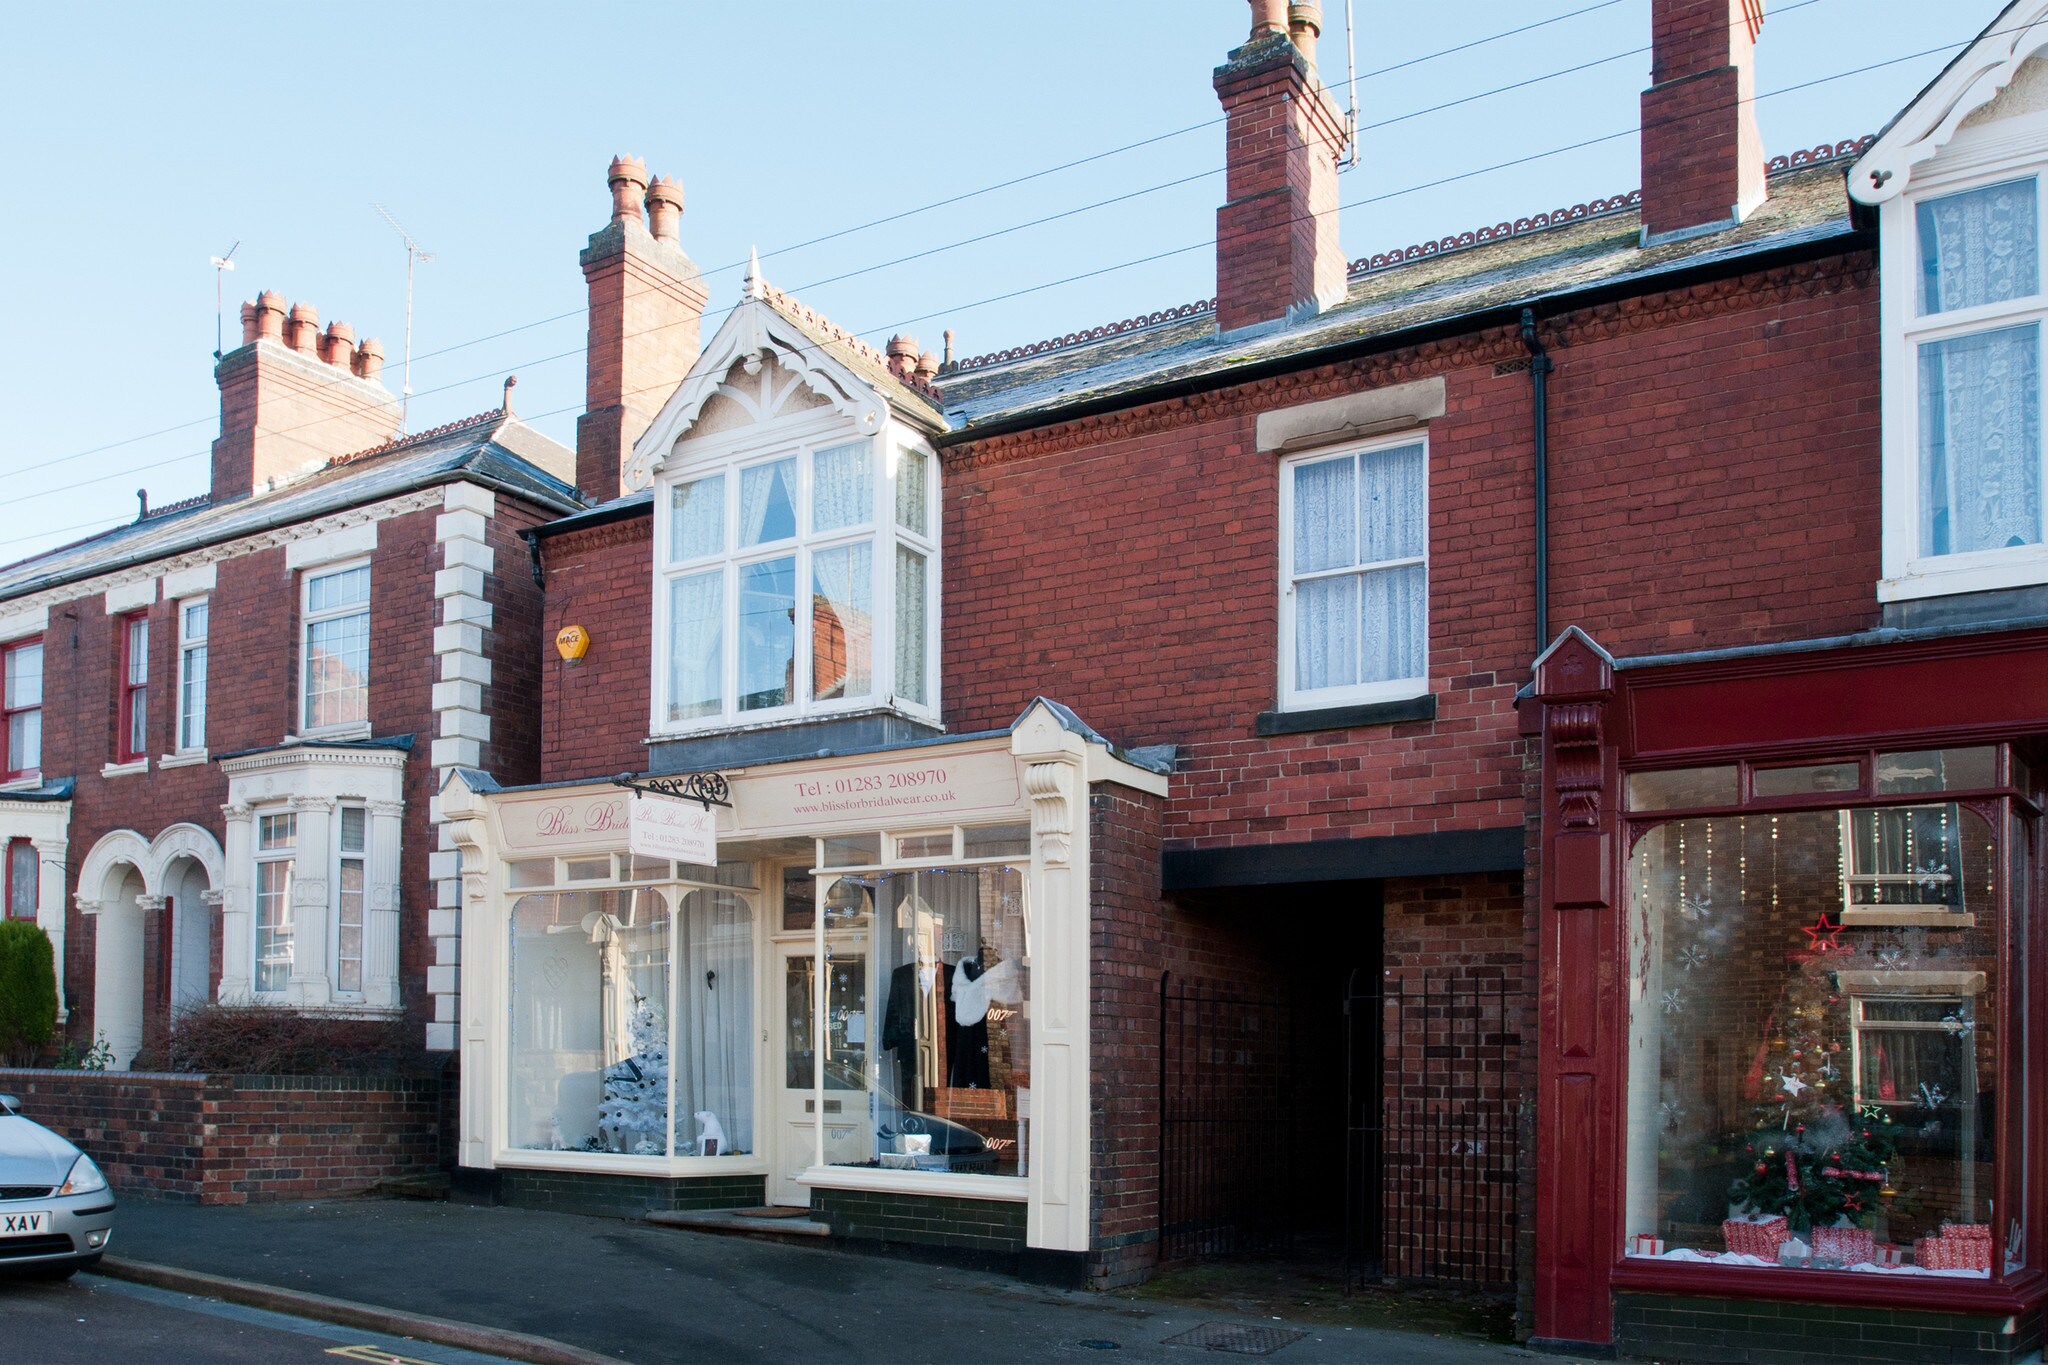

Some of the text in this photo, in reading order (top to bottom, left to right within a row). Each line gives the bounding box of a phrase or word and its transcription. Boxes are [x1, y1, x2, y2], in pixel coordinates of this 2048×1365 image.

[794, 781, 822, 797] Tel
[835, 775, 882, 794] 01283
[888, 768, 947, 789] 208970
[793, 790, 956, 815] www.blissforbridalwear.co.uk
[536, 801, 630, 837] Bliss Brid
[642, 831, 654, 841] Tel
[659, 832, 680, 845] 01283
[681, 837, 705, 849] 208970
[987, 1008, 1009, 1021] 007
[986, 1137, 1006, 1150] 007
[5, 1215, 41, 1232] XAV
